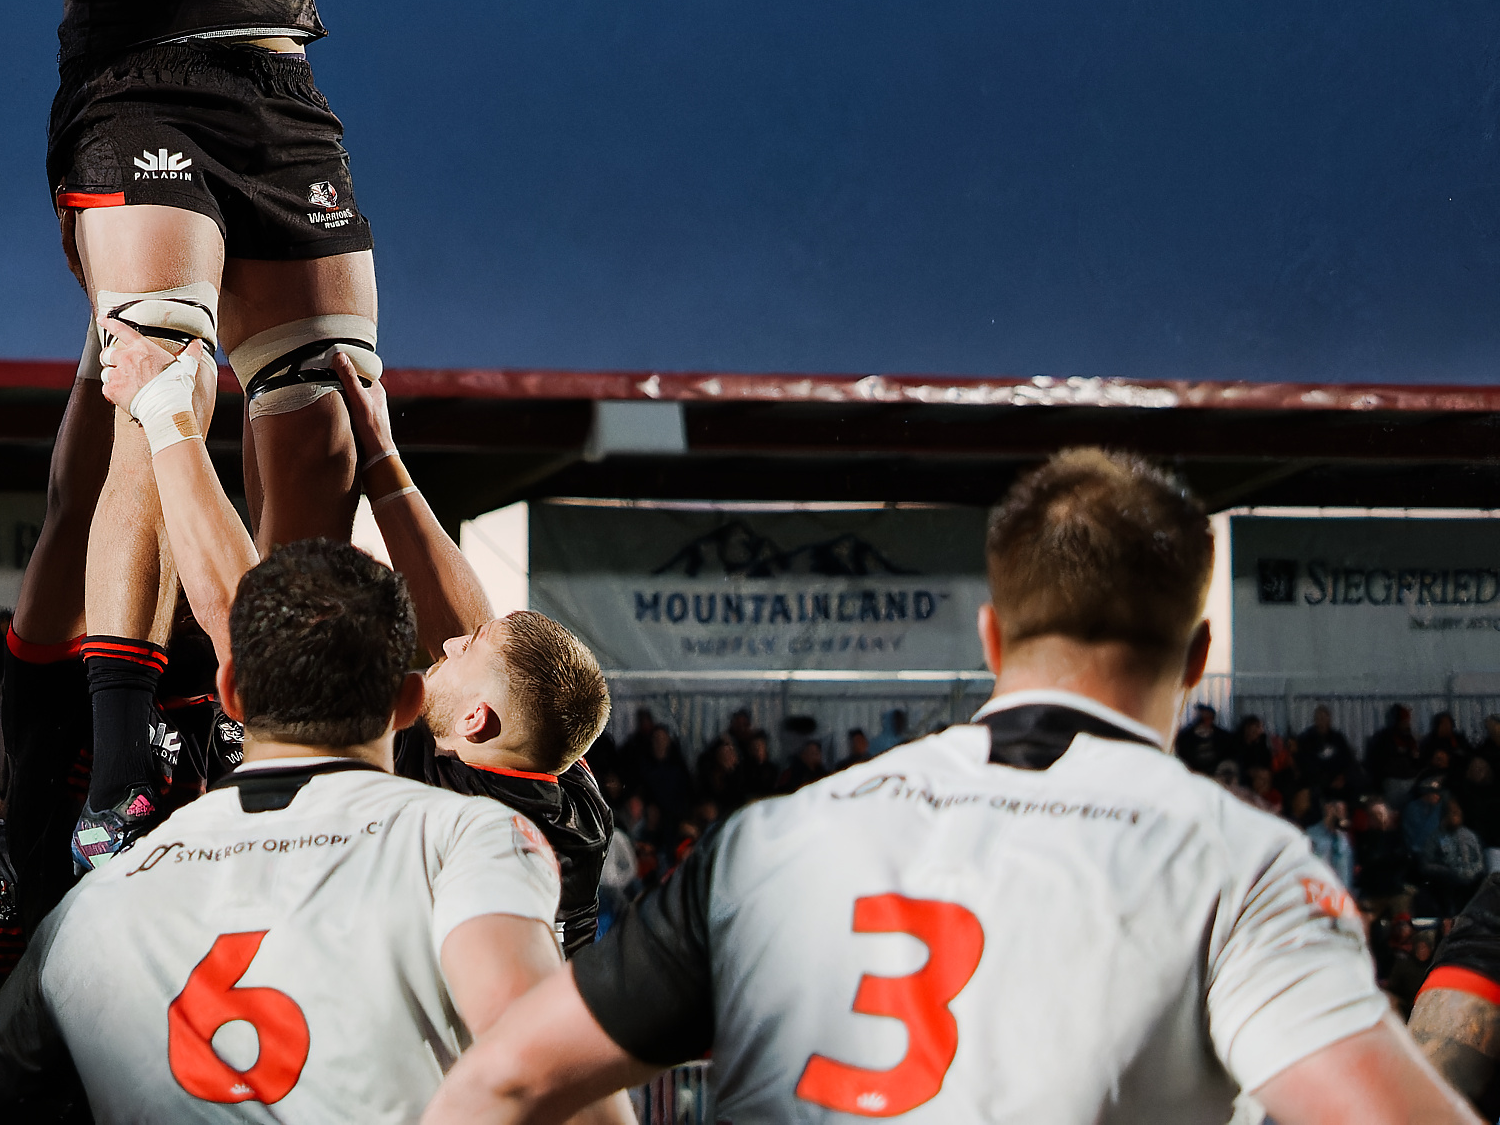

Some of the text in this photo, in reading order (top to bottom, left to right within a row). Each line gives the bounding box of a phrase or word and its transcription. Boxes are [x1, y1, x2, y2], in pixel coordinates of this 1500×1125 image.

[134, 171, 192, 182] PALADIN
[306, 208, 354, 224] WARRIORS
[324, 218, 349, 229] RUGBY
[1304, 561, 1499, 606] SIEGFRIED
[633, 589, 937, 624] MOUNTAINLAND
[174, 839, 259, 863] SYNERGY
[168, 929, 311, 1105] 6
[796, 892, 986, 1118] 3
